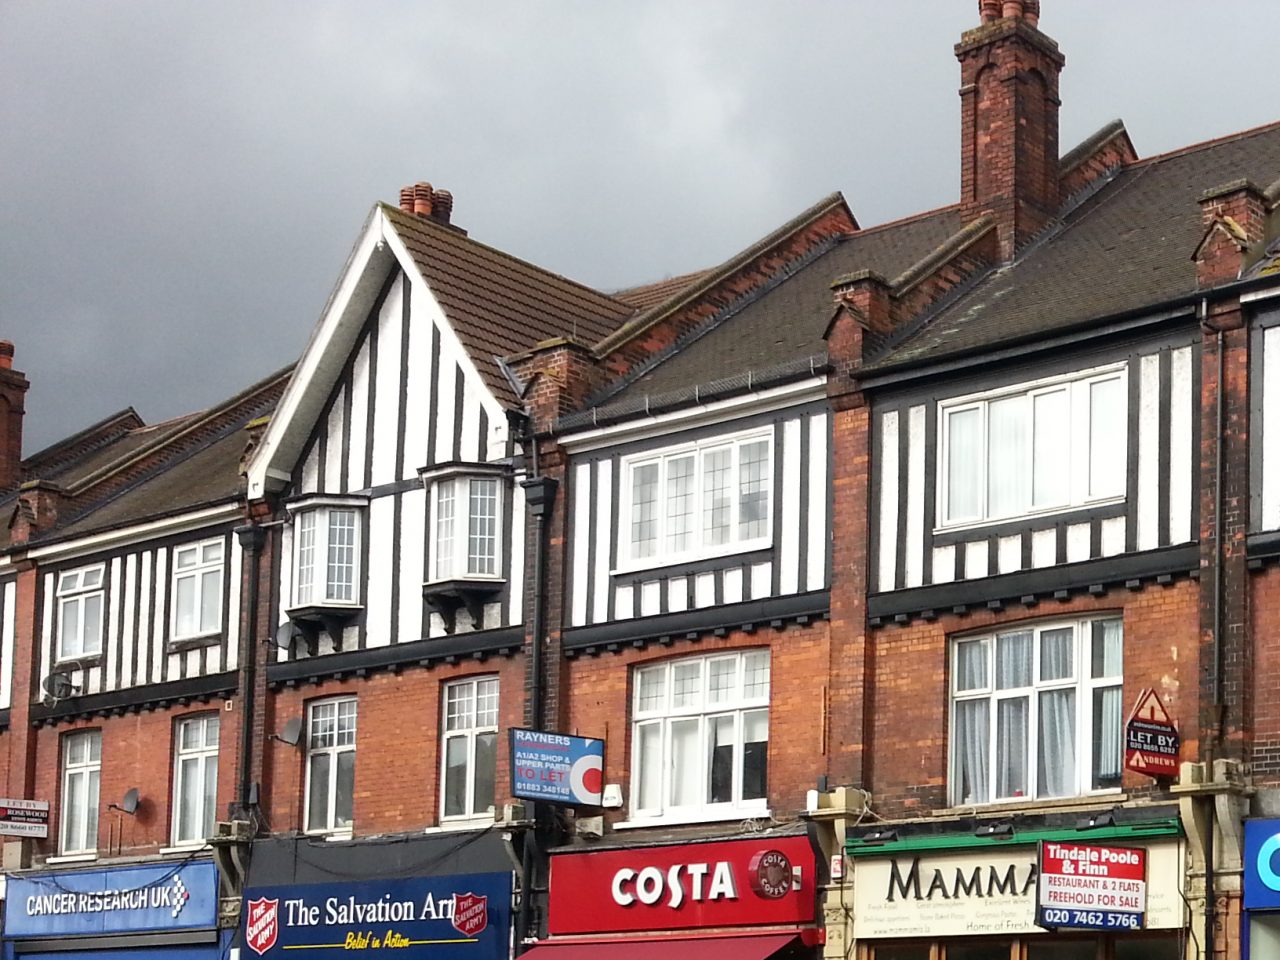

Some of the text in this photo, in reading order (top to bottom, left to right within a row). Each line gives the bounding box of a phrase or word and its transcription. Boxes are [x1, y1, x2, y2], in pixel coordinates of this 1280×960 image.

[516, 731, 571, 746] RAYNERS
[1130, 731, 1175, 747] LET BY
[516, 759, 544, 769] UPPER
[541, 754, 563, 763] SHOP
[517, 767, 565, 783] TO LET
[763, 854, 787, 869] COSTA
[1047, 845, 1140, 865] Tindale Poole
[1062, 860, 1108, 876] & Finn
[611, 861, 739, 909] COSTA
[1048, 876, 1140, 893] RESTAURANT & 2 FLATS
[26, 886, 172, 916] CANCER RESEARCH UK
[1048, 890, 1095, 905] FREEHOLD
[1097, 894, 1116, 906] FOR
[1119, 896, 1139, 908] SALE
[285, 898, 320, 927] The
[325, 893, 415, 925] Salvation
[1045, 909, 1070, 923] 020
[1073, 911, 1104, 925] 7462
[1107, 913, 1138, 927] 5766
[966, 919, 1029, 932] Home of Fresh
[345, 929, 409, 950] Belief in Action
